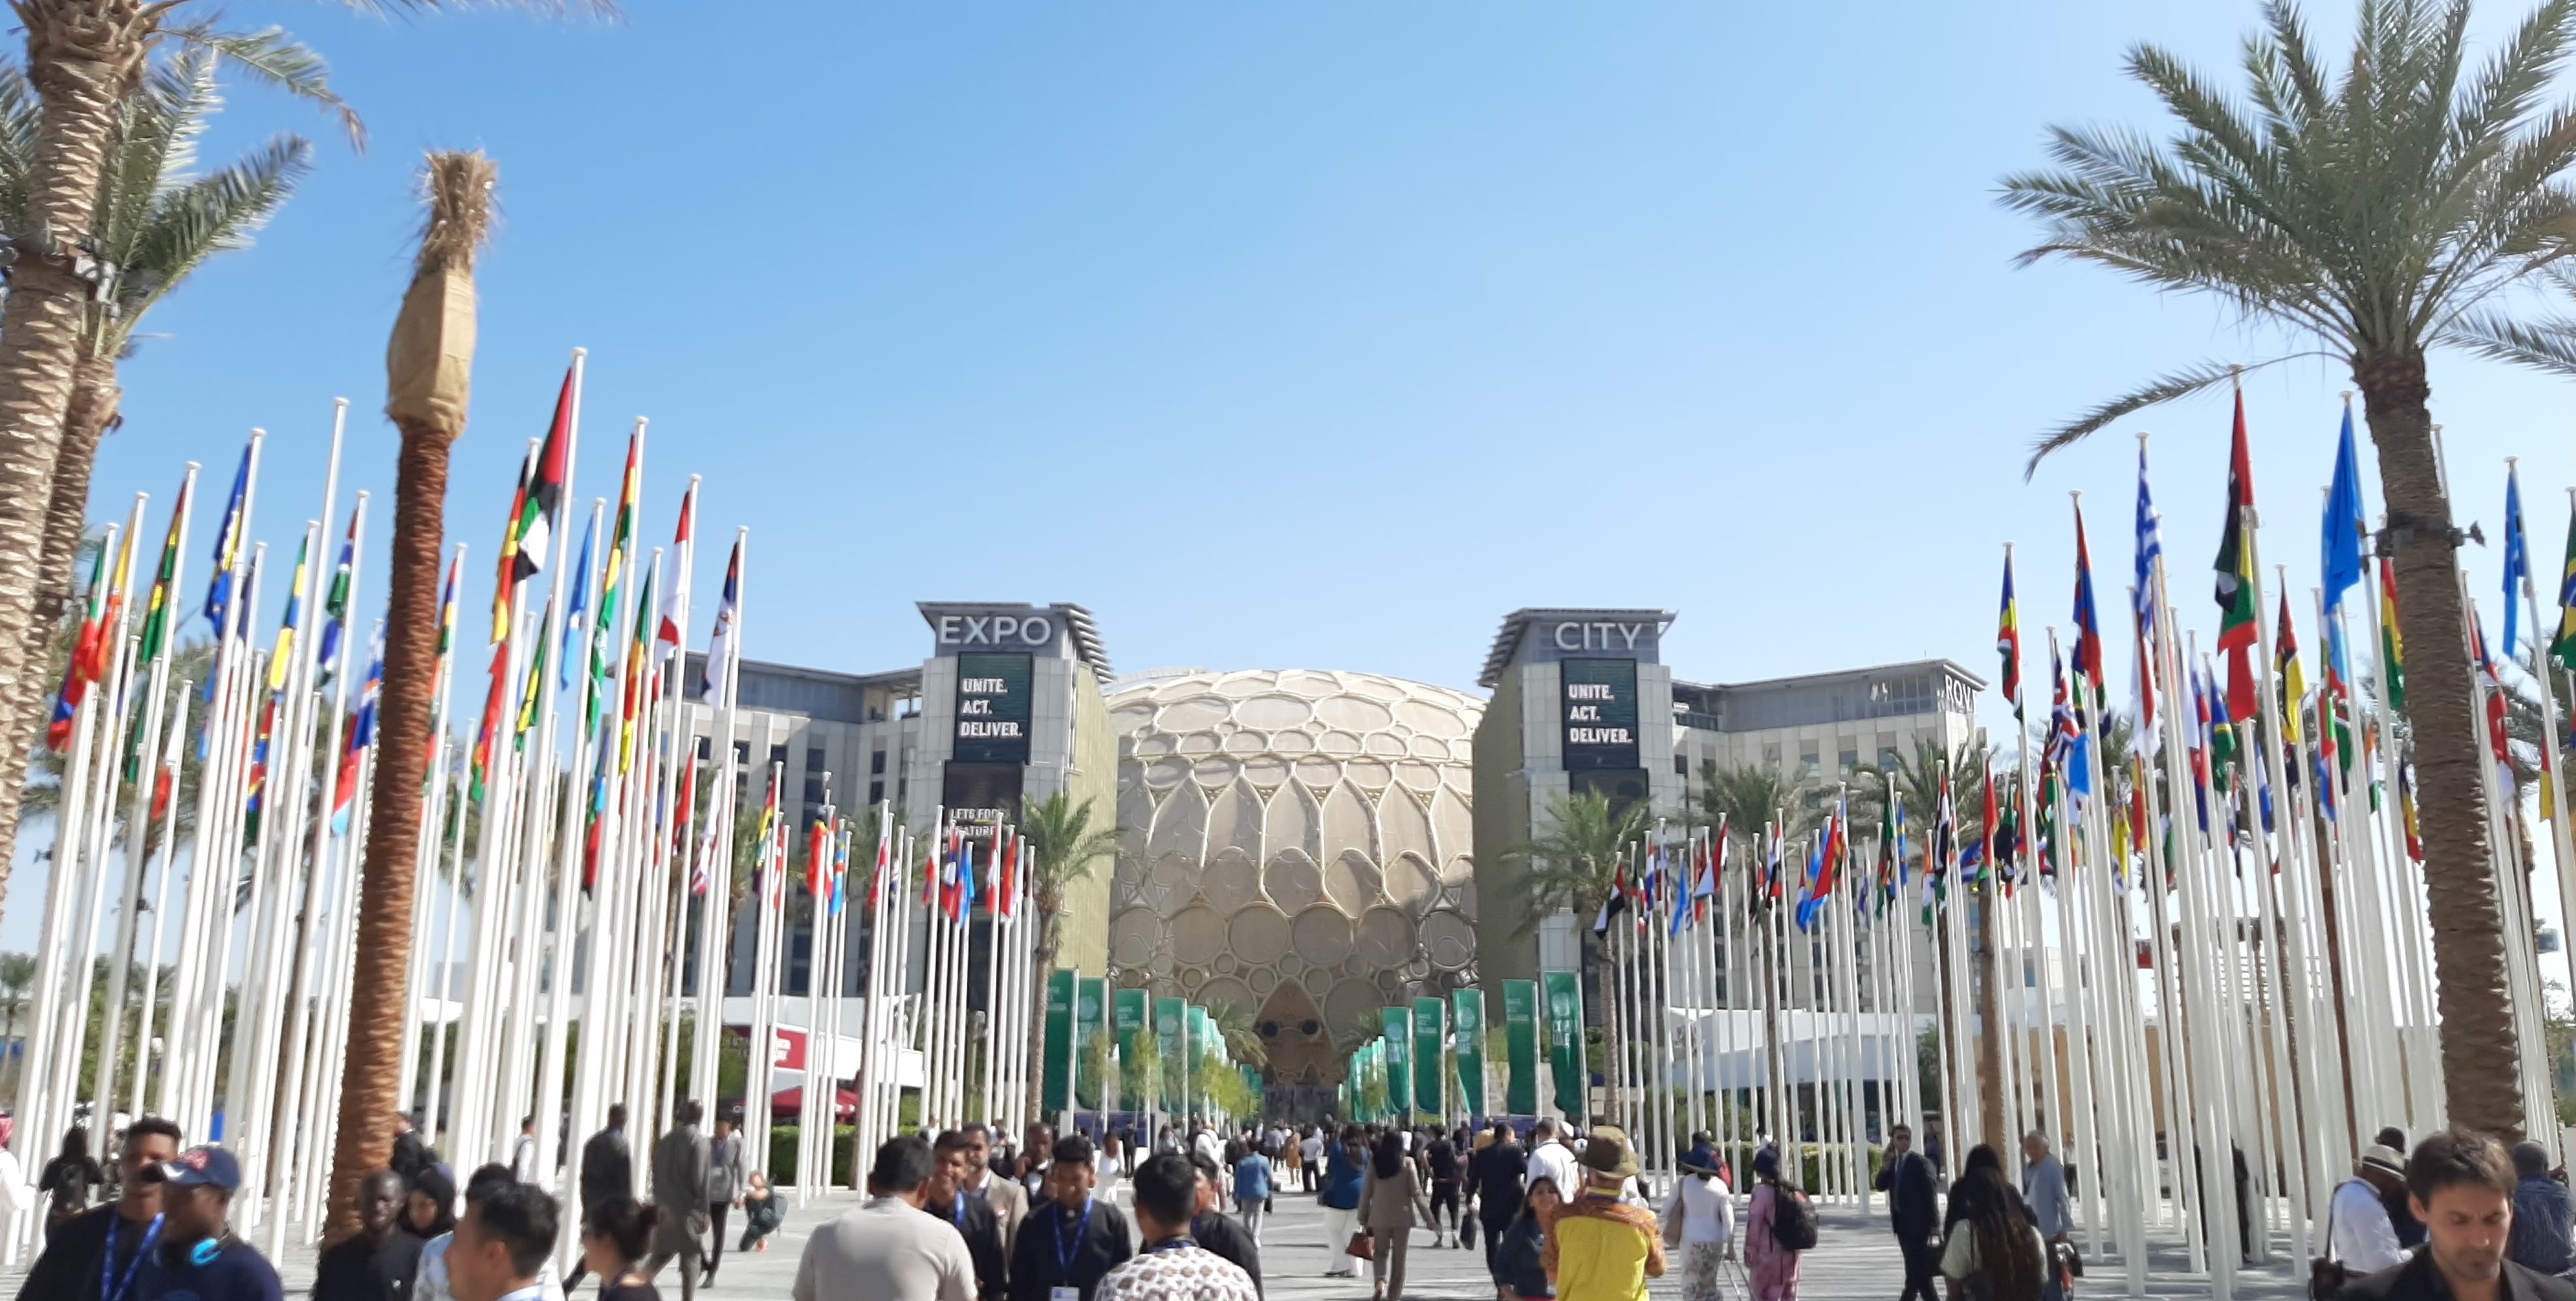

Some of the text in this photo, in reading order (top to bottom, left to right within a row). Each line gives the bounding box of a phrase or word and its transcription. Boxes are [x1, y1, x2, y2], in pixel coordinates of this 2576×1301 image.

[940, 615, 1052, 646] EXPO
[1554, 621, 1642, 650] CITY
[962, 678, 1008, 693] UNITE.
[1569, 684, 1614, 699] UNITE.
[961, 699, 993, 715] ACT.
[1570, 705, 1601, 720] ACT.
[961, 722, 1023, 737] DELIVER.
[1570, 728, 1633, 743] DELIVER.
